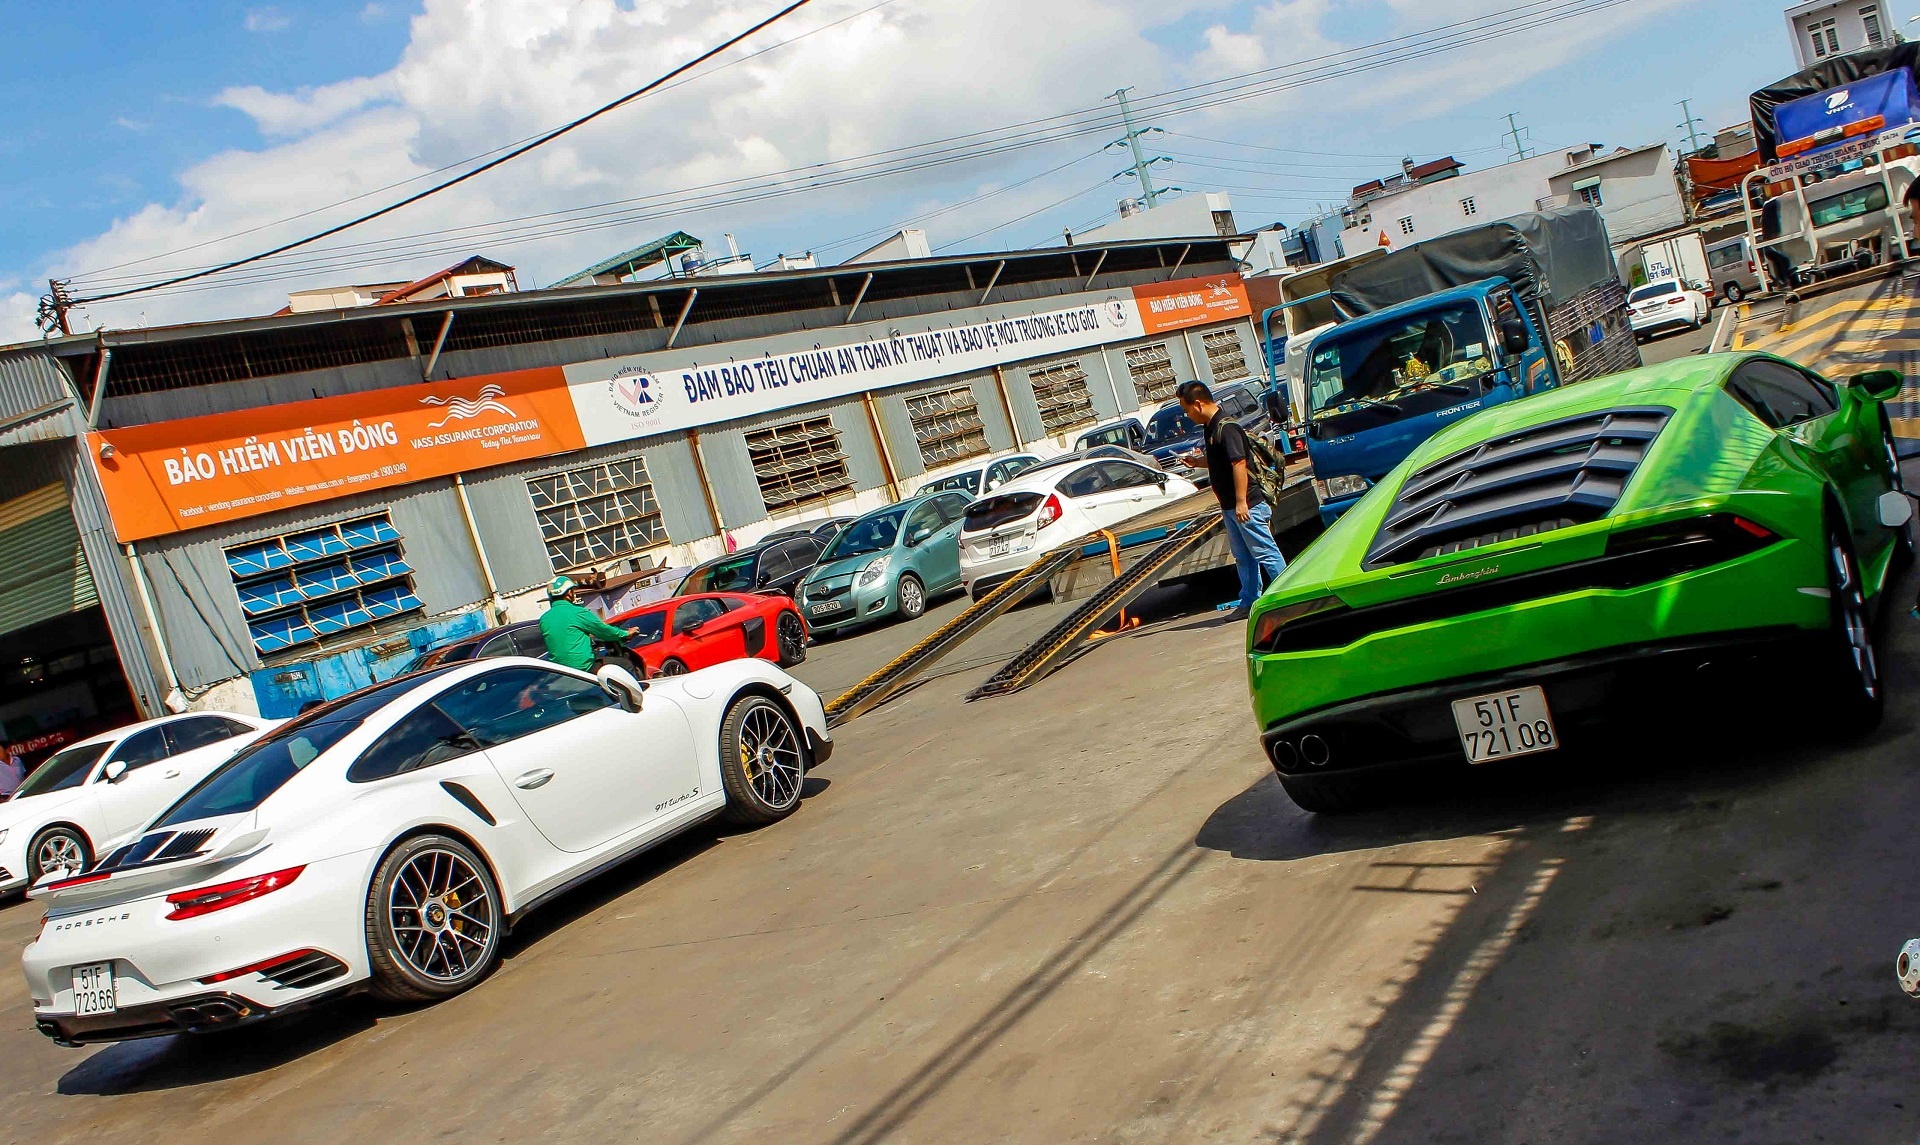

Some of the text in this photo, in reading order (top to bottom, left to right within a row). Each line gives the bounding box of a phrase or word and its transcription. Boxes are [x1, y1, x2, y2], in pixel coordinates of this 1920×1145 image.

[1826, 103, 1854, 114] VNPT
[721, 356, 755, 396] BẢO
[789, 342, 837, 384] CHUẨN
[836, 348, 858, 375] AN
[906, 326, 945, 364] THUẬT
[1052, 313, 1068, 336] XE
[613, 392, 664, 417] VIETNAM REGISTER
[1436, 400, 1480, 418] FRONTIER
[410, 419, 539, 450] VASS ASSURANCE CORPORATION
[631, 421, 644, 430] ISO
[164, 419, 398, 486] BẢO HIỂM VIỄN ĐÔNG
[480, 433, 541, 450] Today Not Tomorrow
[231, 496, 255, 508] assurance
[254, 490, 282, 505] corporation
[346, 472, 371, 486] Emergency
[380, 465, 393, 478] 1900
[1436, 564, 1499, 586] Lamborghini
[1474, 694, 1520, 727] 51F
[1465, 720, 1552, 759] 721.08
[655, 801, 668, 812] 911
[690, 786, 699, 798] S
[56, 913, 130, 931] PORSCHE
[81, 967, 102, 990] 51F
[76, 988, 114, 1014] 723.66
